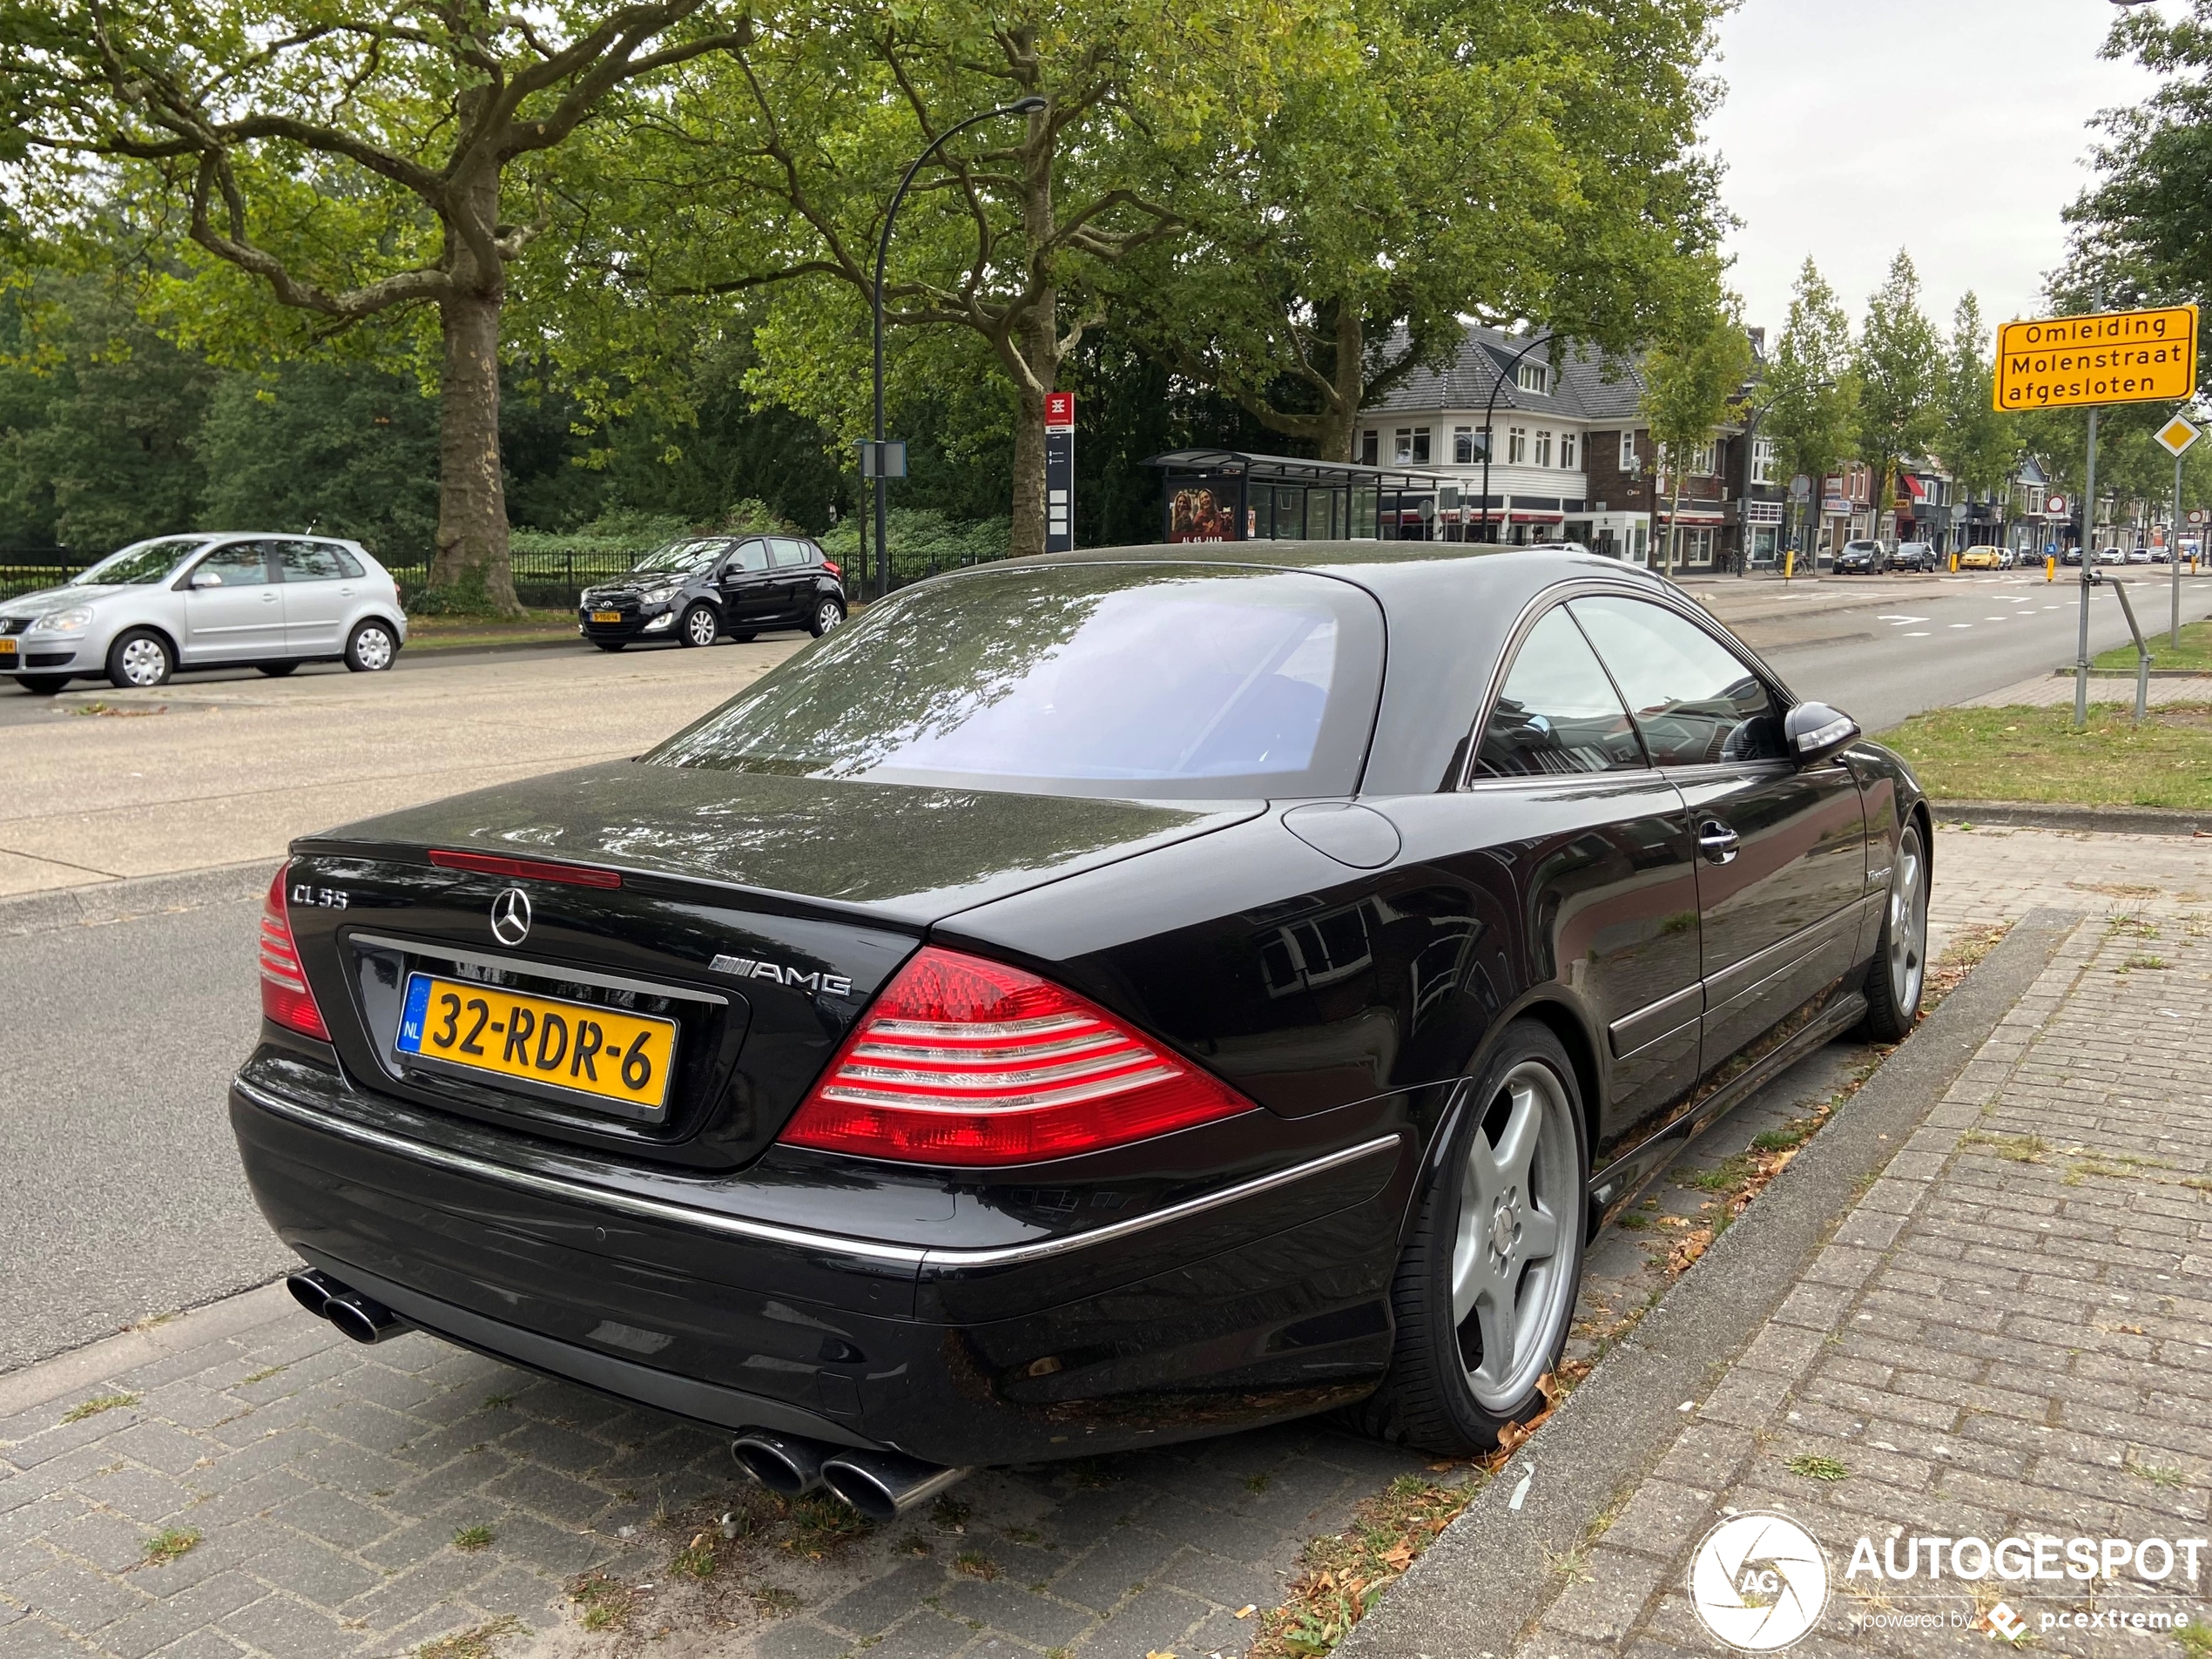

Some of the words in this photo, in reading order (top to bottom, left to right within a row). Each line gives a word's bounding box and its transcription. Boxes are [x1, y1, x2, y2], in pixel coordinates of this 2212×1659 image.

[2026, 317, 2167, 343] Omleiding
[2012, 344, 2182, 374] Molenstraat
[2008, 376, 2155, 403] afgesloten
[293, 884, 315, 905] CL
[319, 887, 348, 911] 55
[749, 961, 853, 996] AMG
[403, 1021, 420, 1040] NL
[432, 993, 652, 1089] 32-RDR-6
